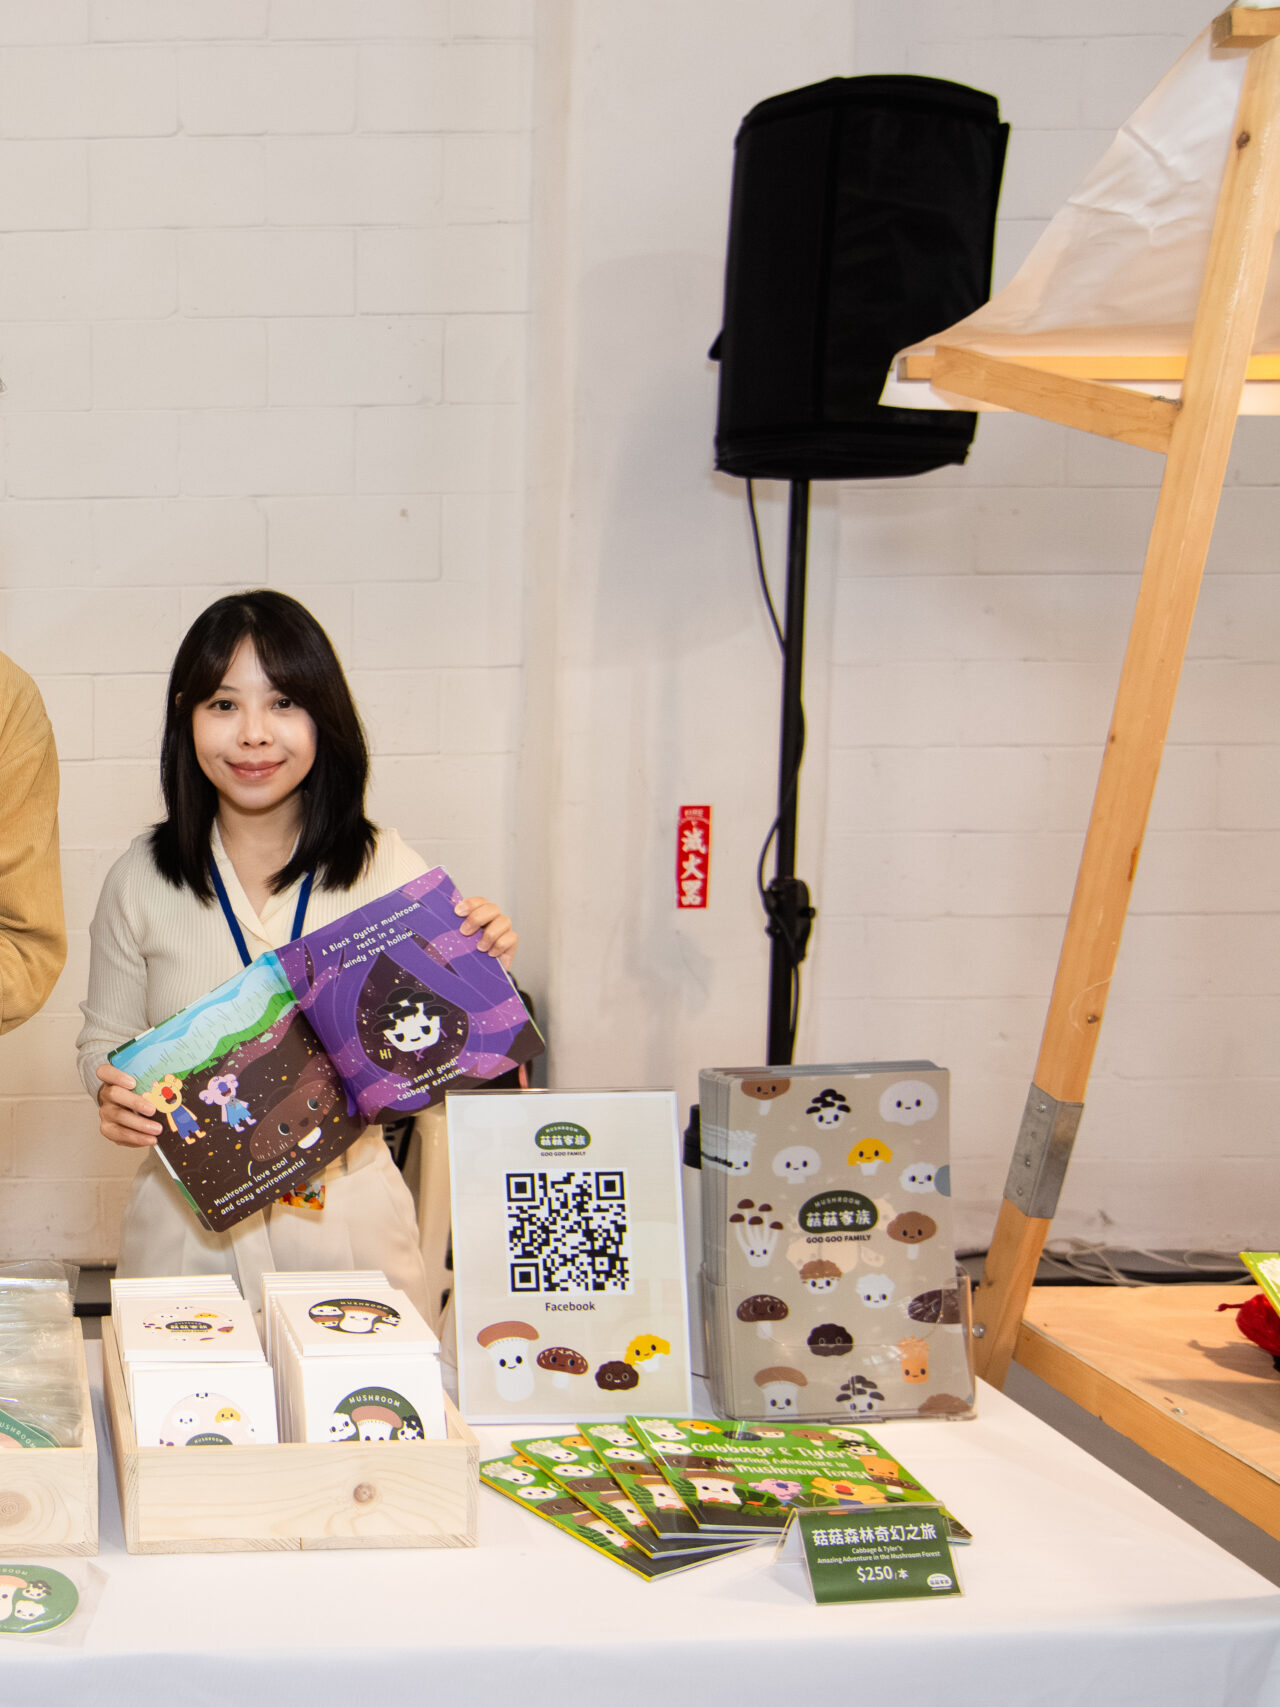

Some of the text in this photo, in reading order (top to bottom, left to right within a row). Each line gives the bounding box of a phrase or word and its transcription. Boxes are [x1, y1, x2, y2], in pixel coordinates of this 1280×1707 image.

[321, 902, 420, 956] A Black Oyster mushroom
[356, 937, 376, 950] rests
[377, 932, 387, 945] in
[343, 930, 416, 969] windy tree hollow.
[379, 1048, 392, 1060] Hi
[413, 1068, 435, 1083] smell
[397, 1067, 469, 1101] Cabbage exclaims.
[214, 1157, 289, 1207] Mushrooms love cool
[220, 1158, 307, 1215] and cozy environments!
[814, 1197, 861, 1208] MUSHROOM
[806, 1210, 872, 1228] 菇菇家族
[806, 1236, 824, 1244] GOO
[825, 1235, 843, 1243] GOO
[545, 1301, 596, 1312] Facebook
[348, 1394, 401, 1408] MUSHROOM
[690, 1442, 775, 1457] Cabbage
[734, 1464, 823, 1477] Mushroom
[821, 1467, 874, 1481] Forest
[811, 1522, 937, 1547] 菇菇森林奇幻之旅
[817, 1556, 843, 1564] Amazing
[890, 1552, 922, 1560] Mushroom
[921, 1550, 941, 1558] Forest
[851, 1547, 877, 1555] Cabbage
